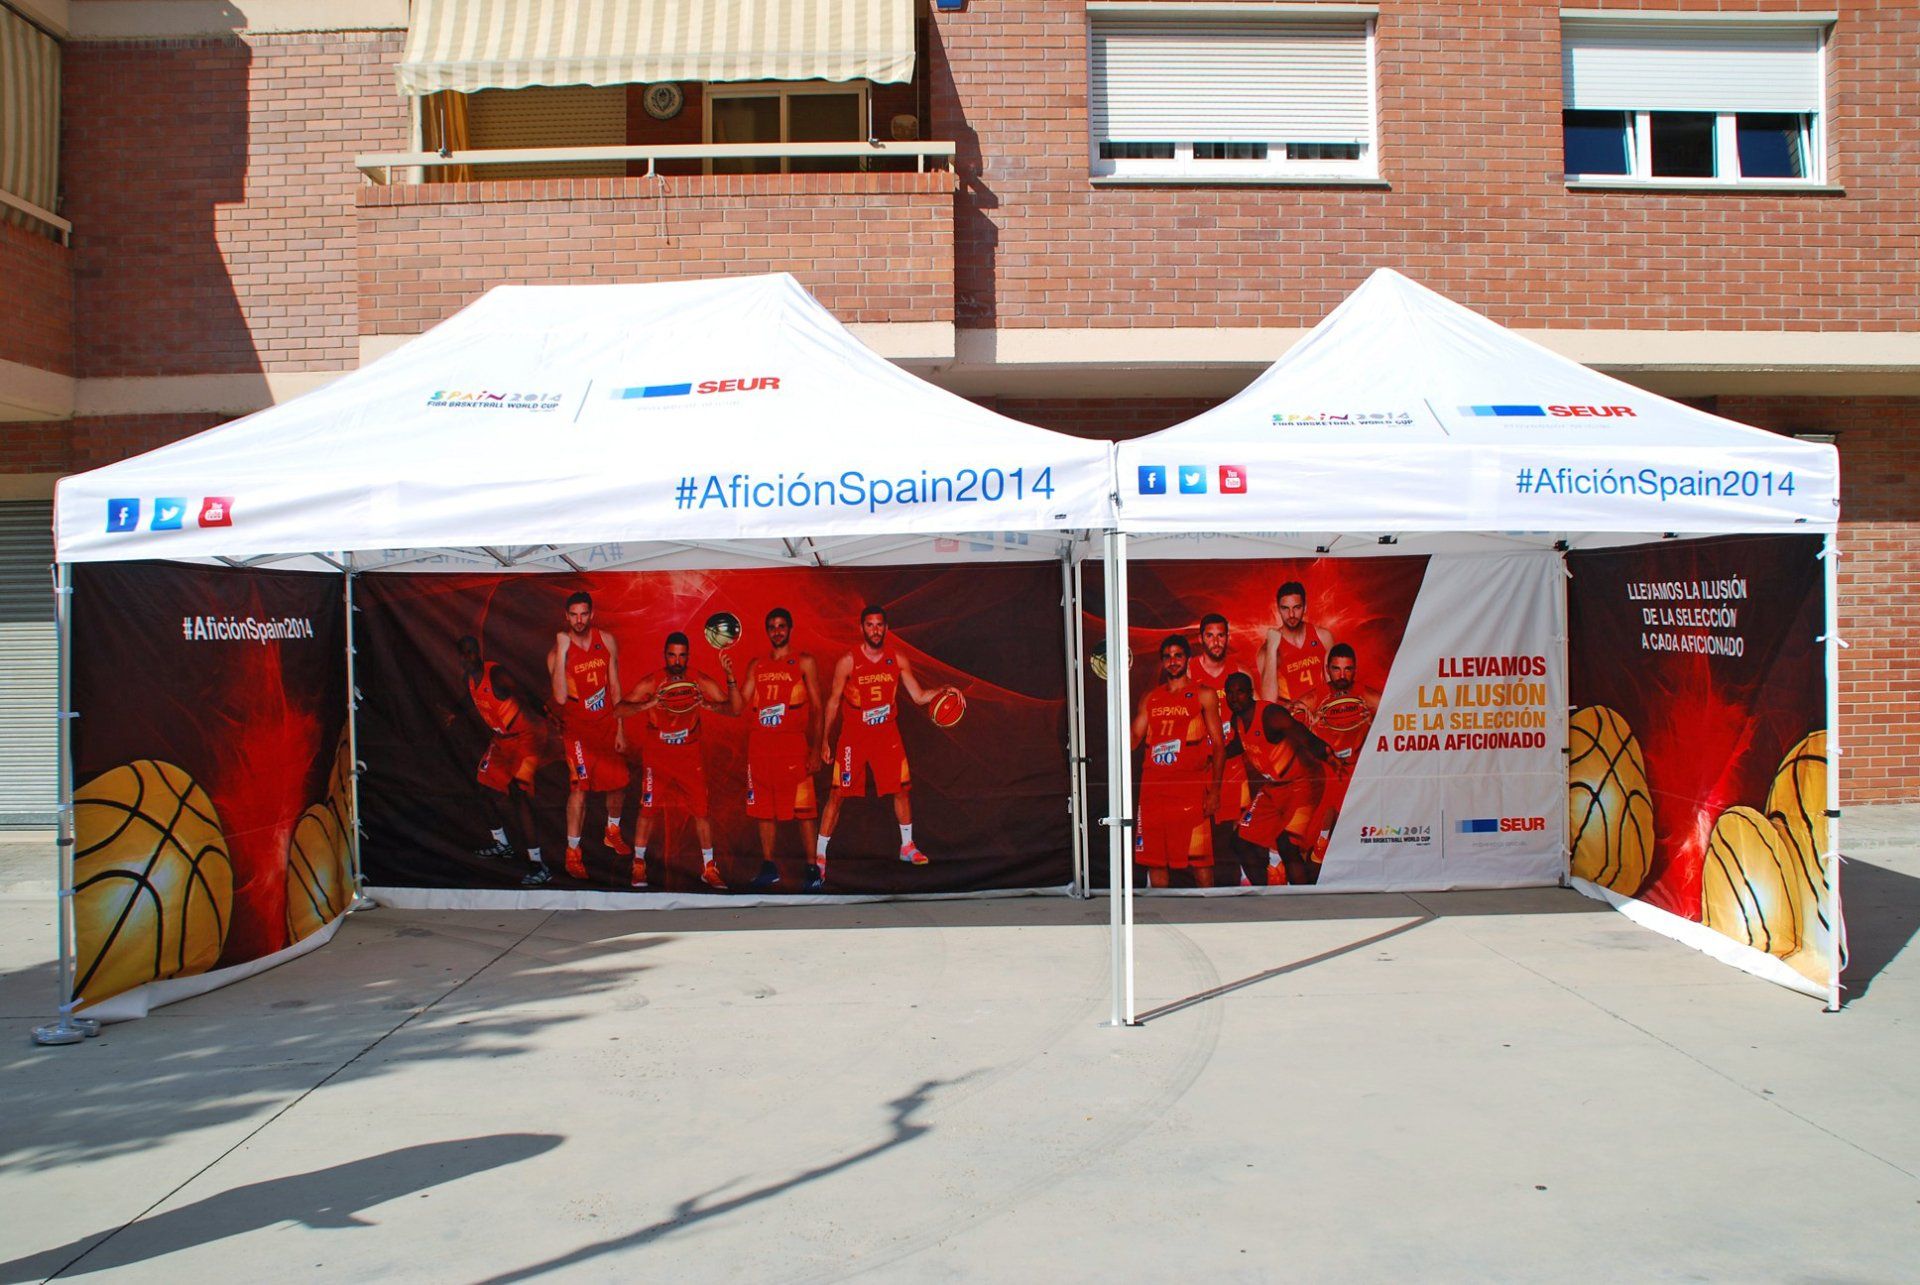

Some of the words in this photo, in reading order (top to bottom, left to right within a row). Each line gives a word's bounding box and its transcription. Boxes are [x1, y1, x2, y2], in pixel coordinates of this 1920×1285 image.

[697, 377, 781, 395] SEUR
[509, 393, 563, 402] 2014
[1547, 405, 1639, 418] SEUR
[675, 466, 1055, 514] #AficiónSpain2014
[1516, 468, 1796, 502] #AficiónSpain2014
[1684, 581, 1700, 599] LA
[1701, 573, 1747, 599] ILUSIÓN
[1643, 608, 1659, 625] DE
[1660, 608, 1675, 625] LA
[1676, 603, 1737, 628] SELECCIÓN
[183, 616, 313, 645] #AficiónSpain2014
[1641, 632, 1649, 649] A
[1650, 632, 1680, 651] CADA
[1681, 634, 1744, 657] AFICIONADO
[574, 658, 606, 674] ESPAÑA
[1438, 656, 1546, 678] LLEVAMOS
[586, 672, 598, 686] 4
[758, 671, 792, 682] ESPAÑA
[859, 672, 894, 685] ESPAÑA
[1300, 669, 1313, 686] 4
[766, 684, 779, 700] 11
[870, 686, 882, 701] 5
[1418, 685, 1448, 708] LA
[1455, 678, 1546, 707] ILUSIÓN
[1151, 705, 1189, 717] ESPAÑA
[1393, 713, 1416, 731] DE
[1423, 713, 1444, 730] LA
[1450, 707, 1546, 730] SELECCIÓN
[1376, 735, 1389, 752] A
[1394, 734, 1440, 751] CADA
[1444, 732, 1546, 750] AFICIONADO
[1403, 826, 1431, 835] 2014
[1500, 817, 1545, 832] SEUR
